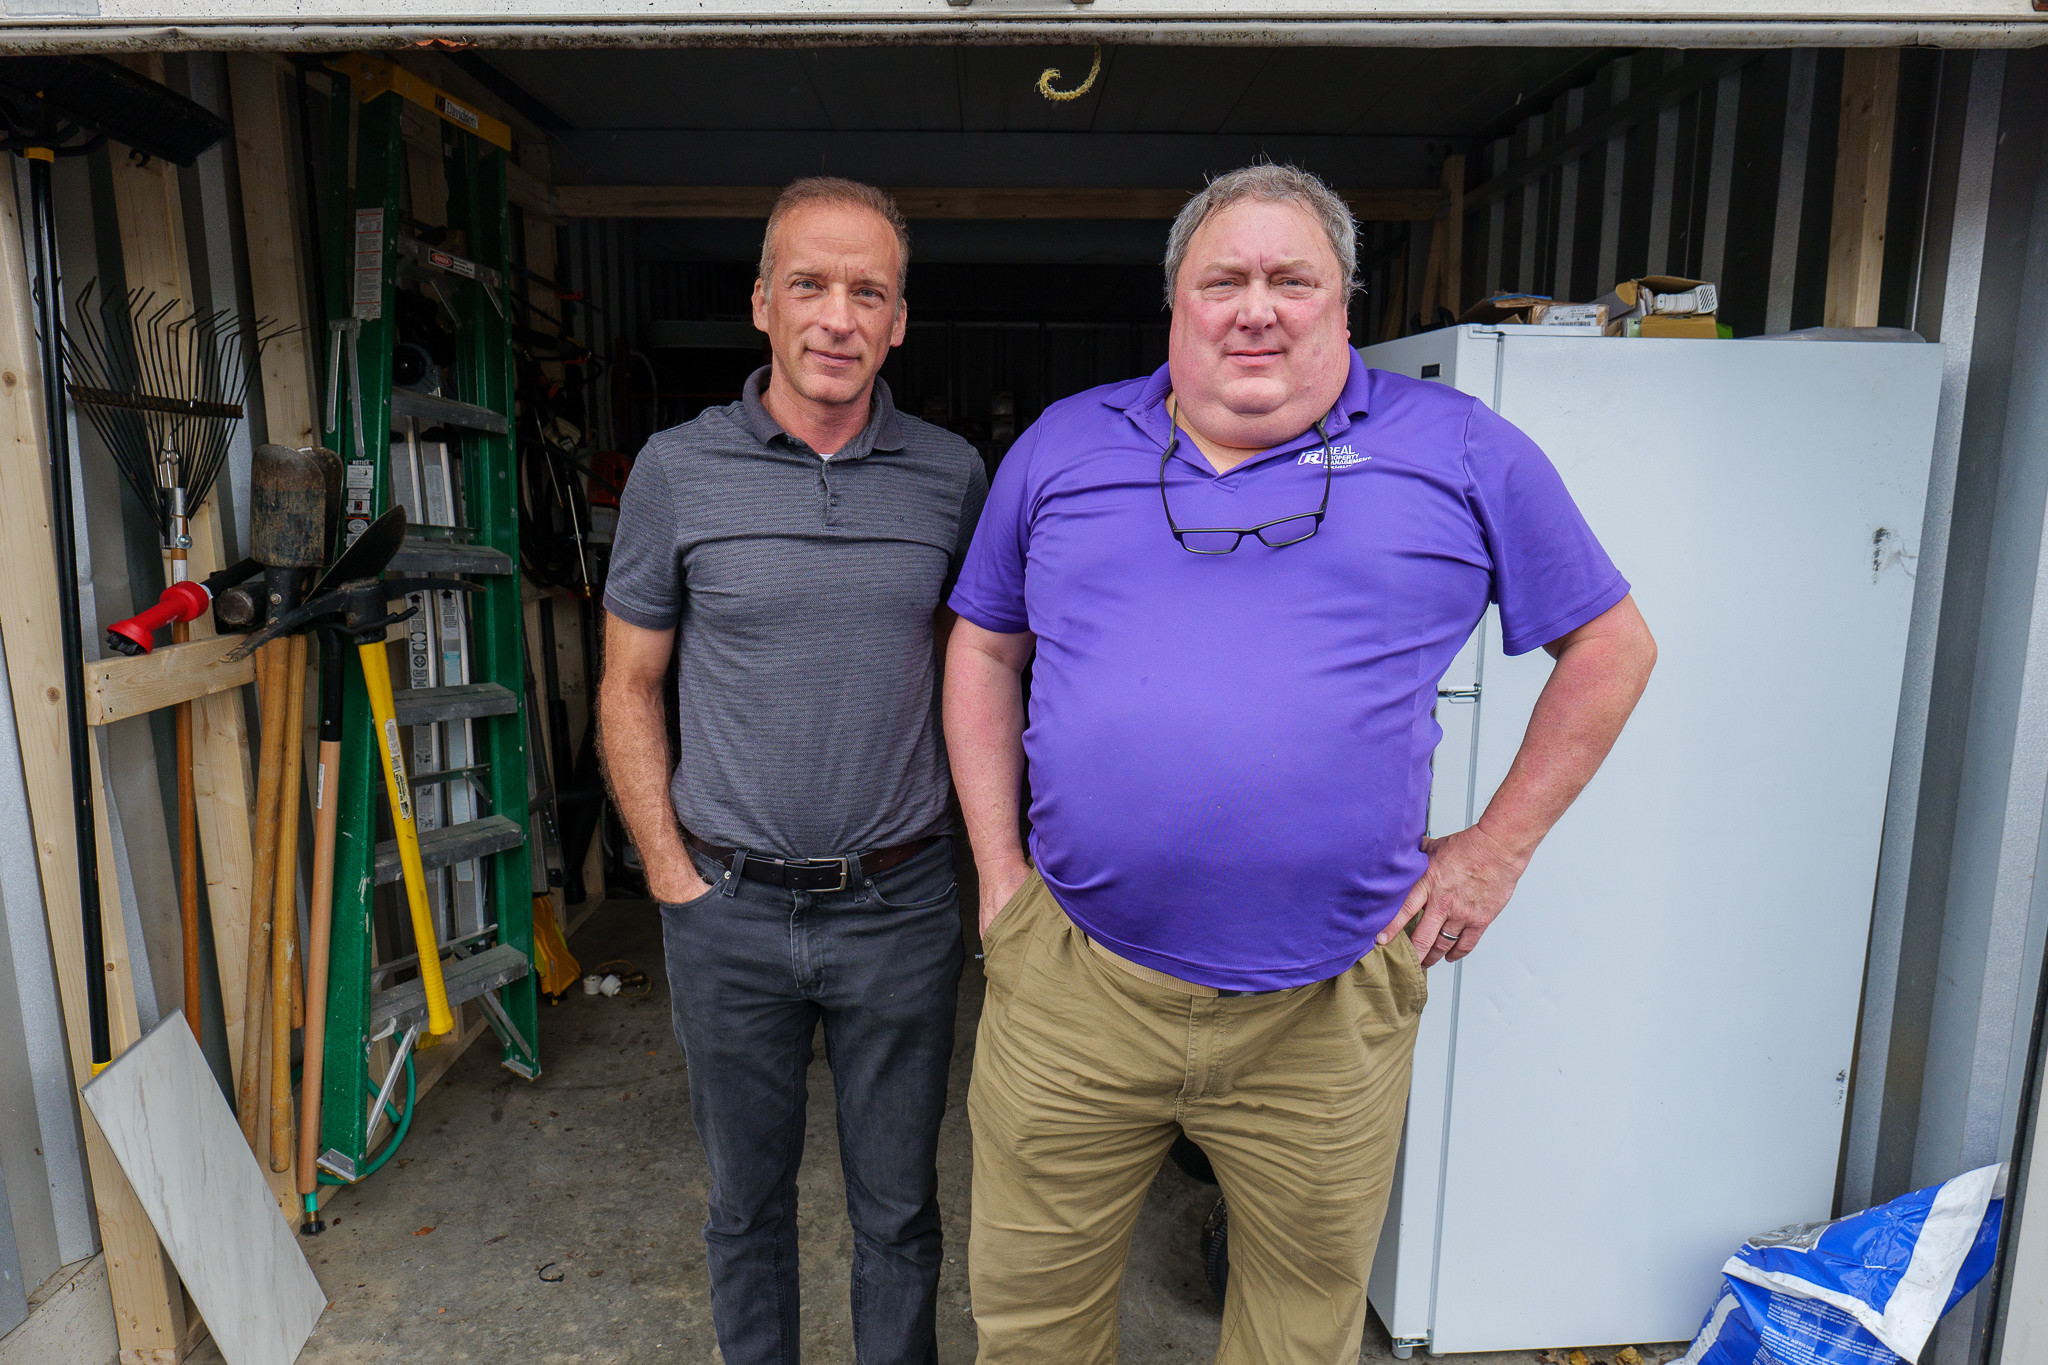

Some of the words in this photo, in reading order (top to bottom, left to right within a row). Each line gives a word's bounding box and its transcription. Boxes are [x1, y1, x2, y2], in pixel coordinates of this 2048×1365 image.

[447, 102, 477, 127] Davidson
[1769, 1302, 1801, 1318] DISCLAIMER
[1764, 1325, 1789, 1340] PRIMEROS
[1791, 1339, 1815, 1352] AUXILIOS
